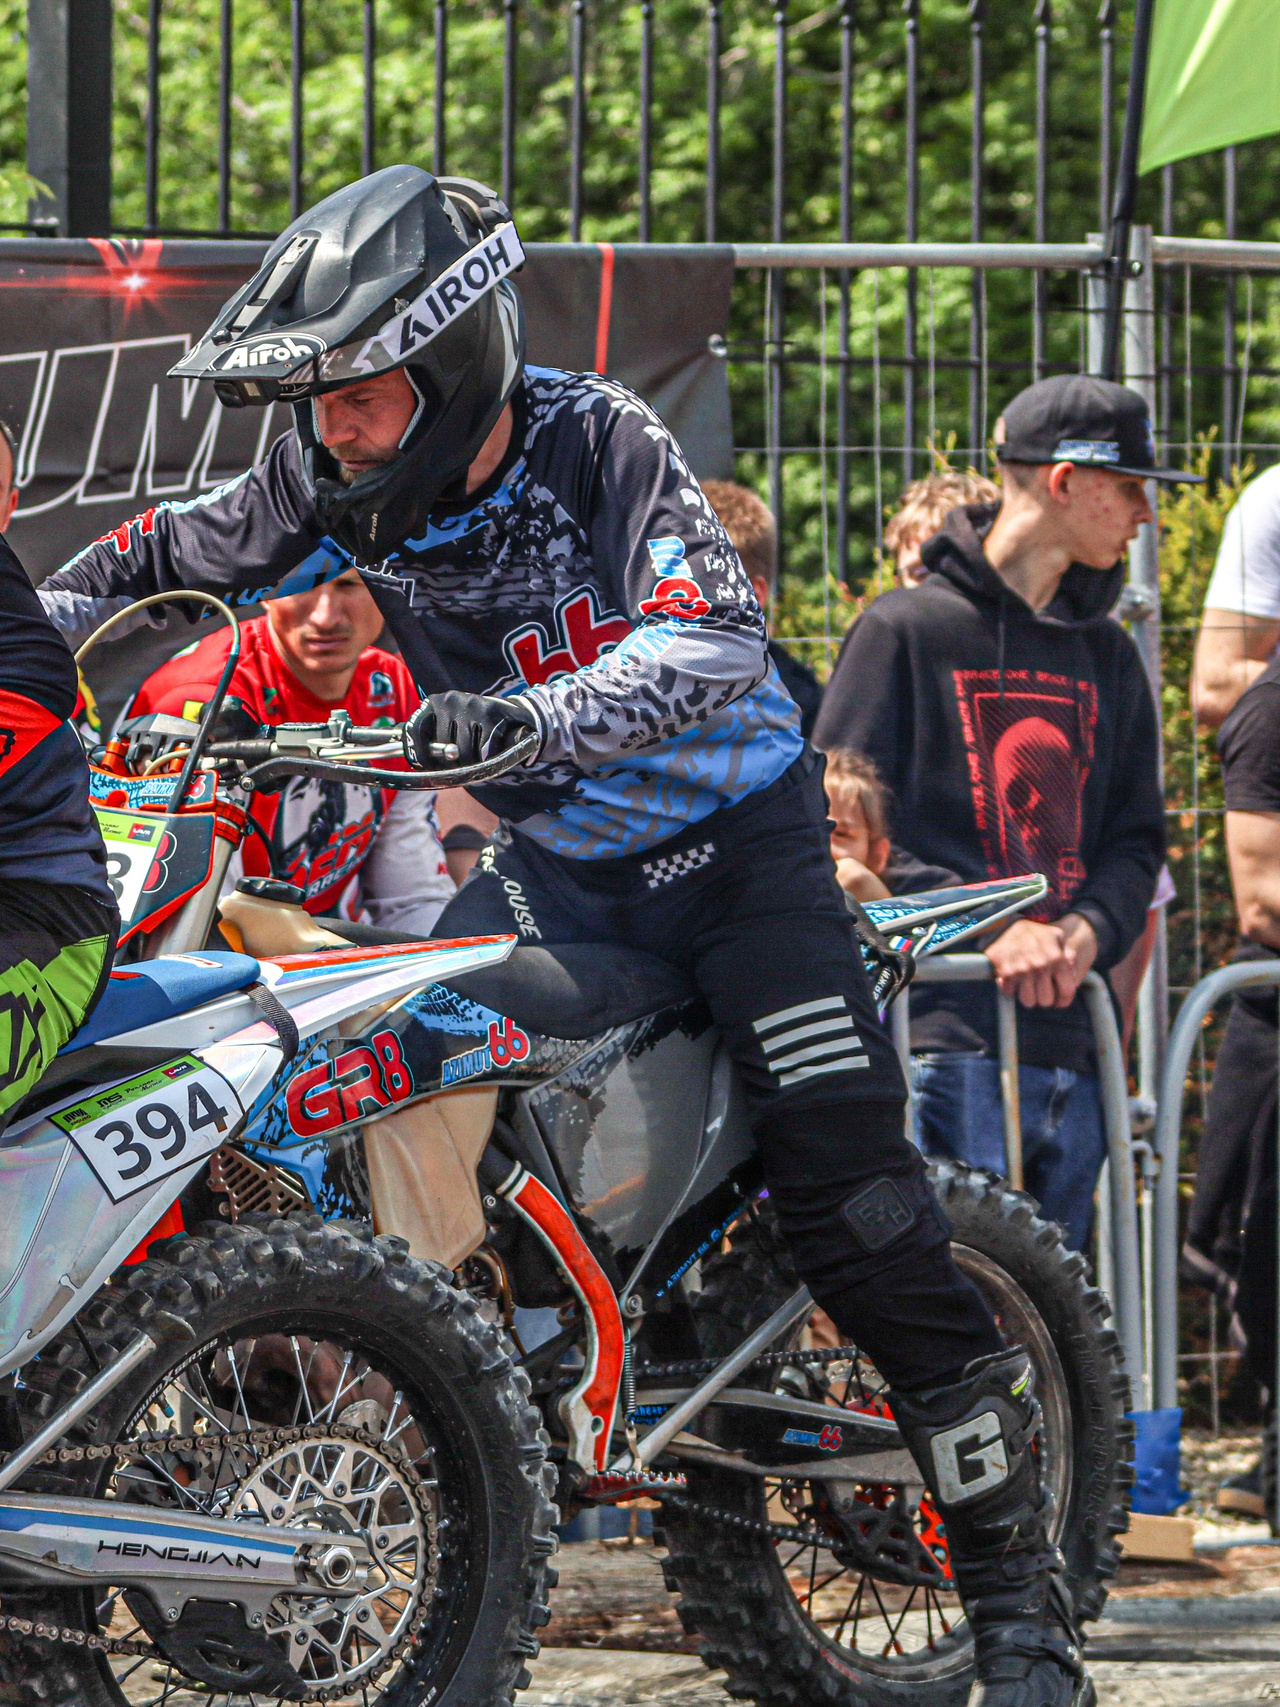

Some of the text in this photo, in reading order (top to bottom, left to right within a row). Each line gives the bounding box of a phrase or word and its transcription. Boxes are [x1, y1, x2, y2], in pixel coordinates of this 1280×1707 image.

[399, 237, 512, 356] AIROH
[221, 337, 316, 371] Airoh
[368, 512, 379, 541] Airoh
[285, 1028, 416, 1138] GR8
[442, 1017, 531, 1088] AZIMUT 66
[93, 1081, 230, 1181] 394
[818, 1424, 843, 1451] 66
[930, 1411, 1009, 1504] G
[97, 1539, 262, 1570] HENGJIAN
